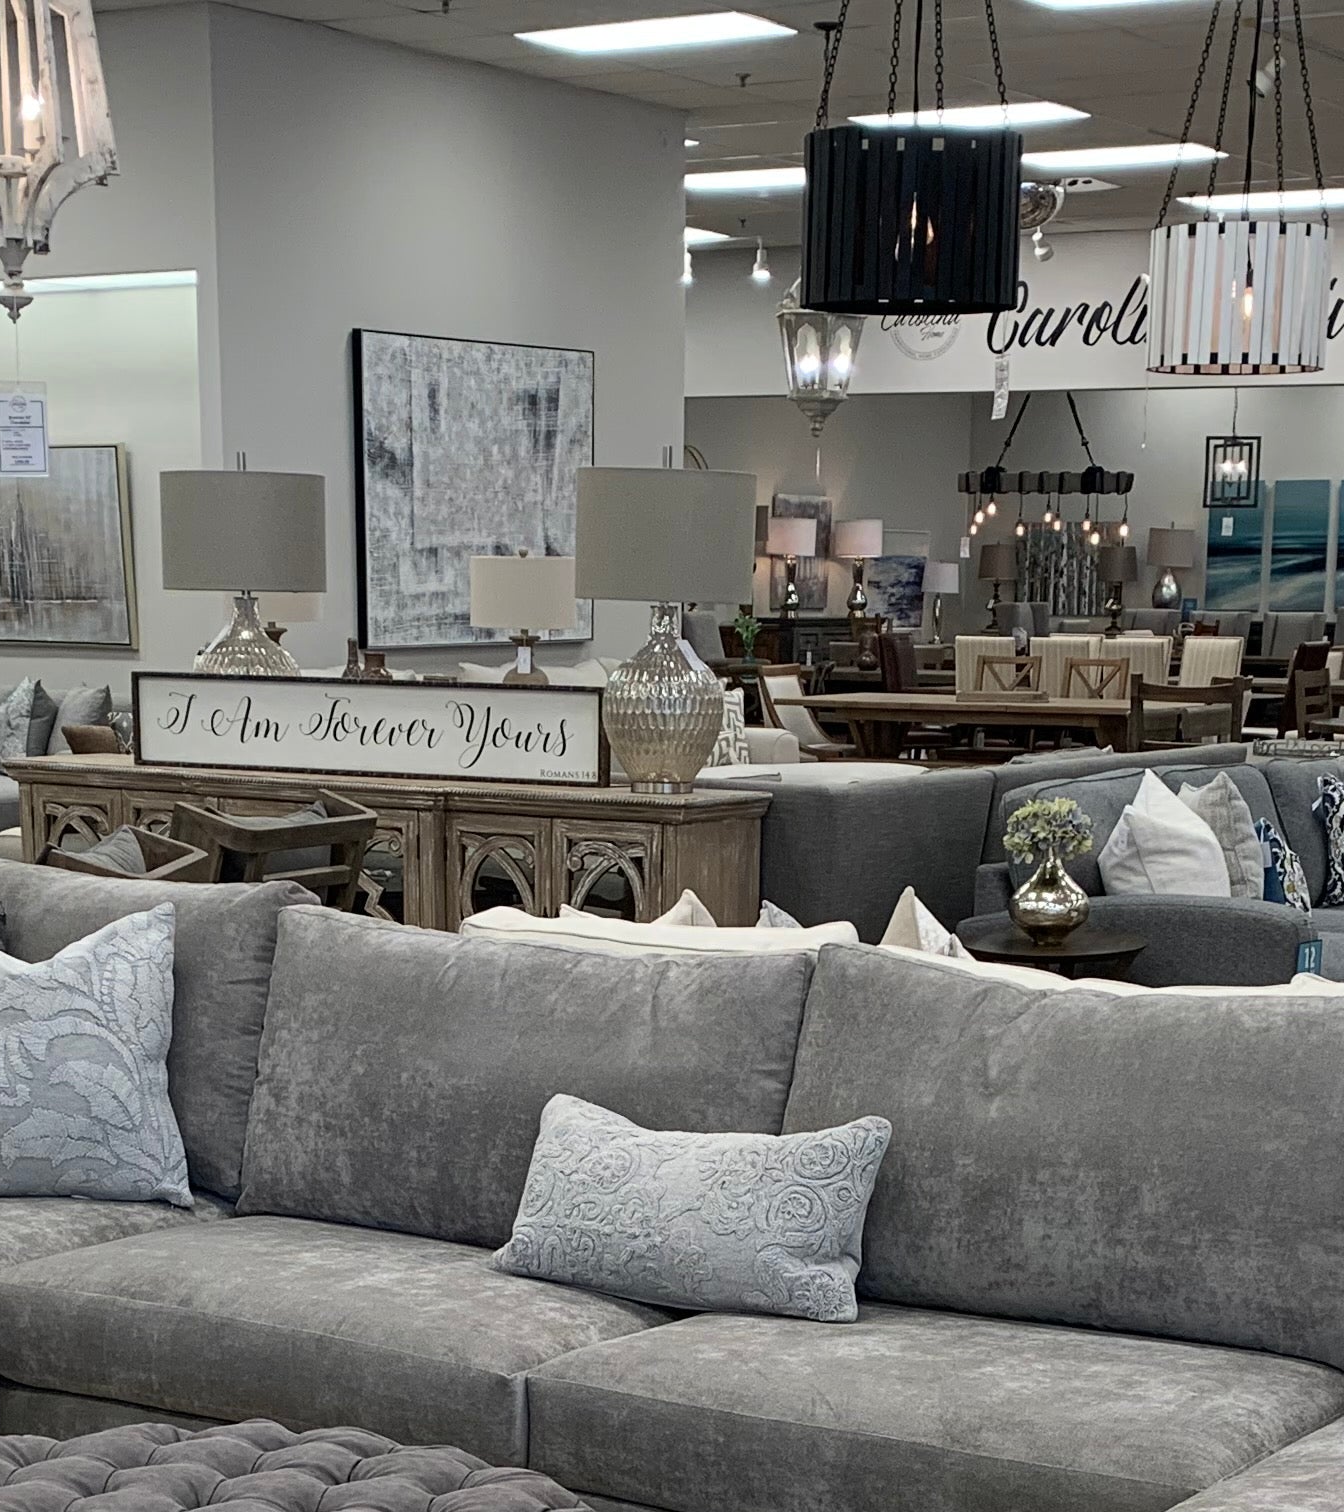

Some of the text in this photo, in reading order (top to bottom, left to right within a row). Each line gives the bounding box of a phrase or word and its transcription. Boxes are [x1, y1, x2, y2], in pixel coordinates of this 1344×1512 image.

[987, 273, 1149, 354] Caroli
[157, 691, 574, 769] I Am Forever Yours
[539, 768, 580, 779] ROMANS
